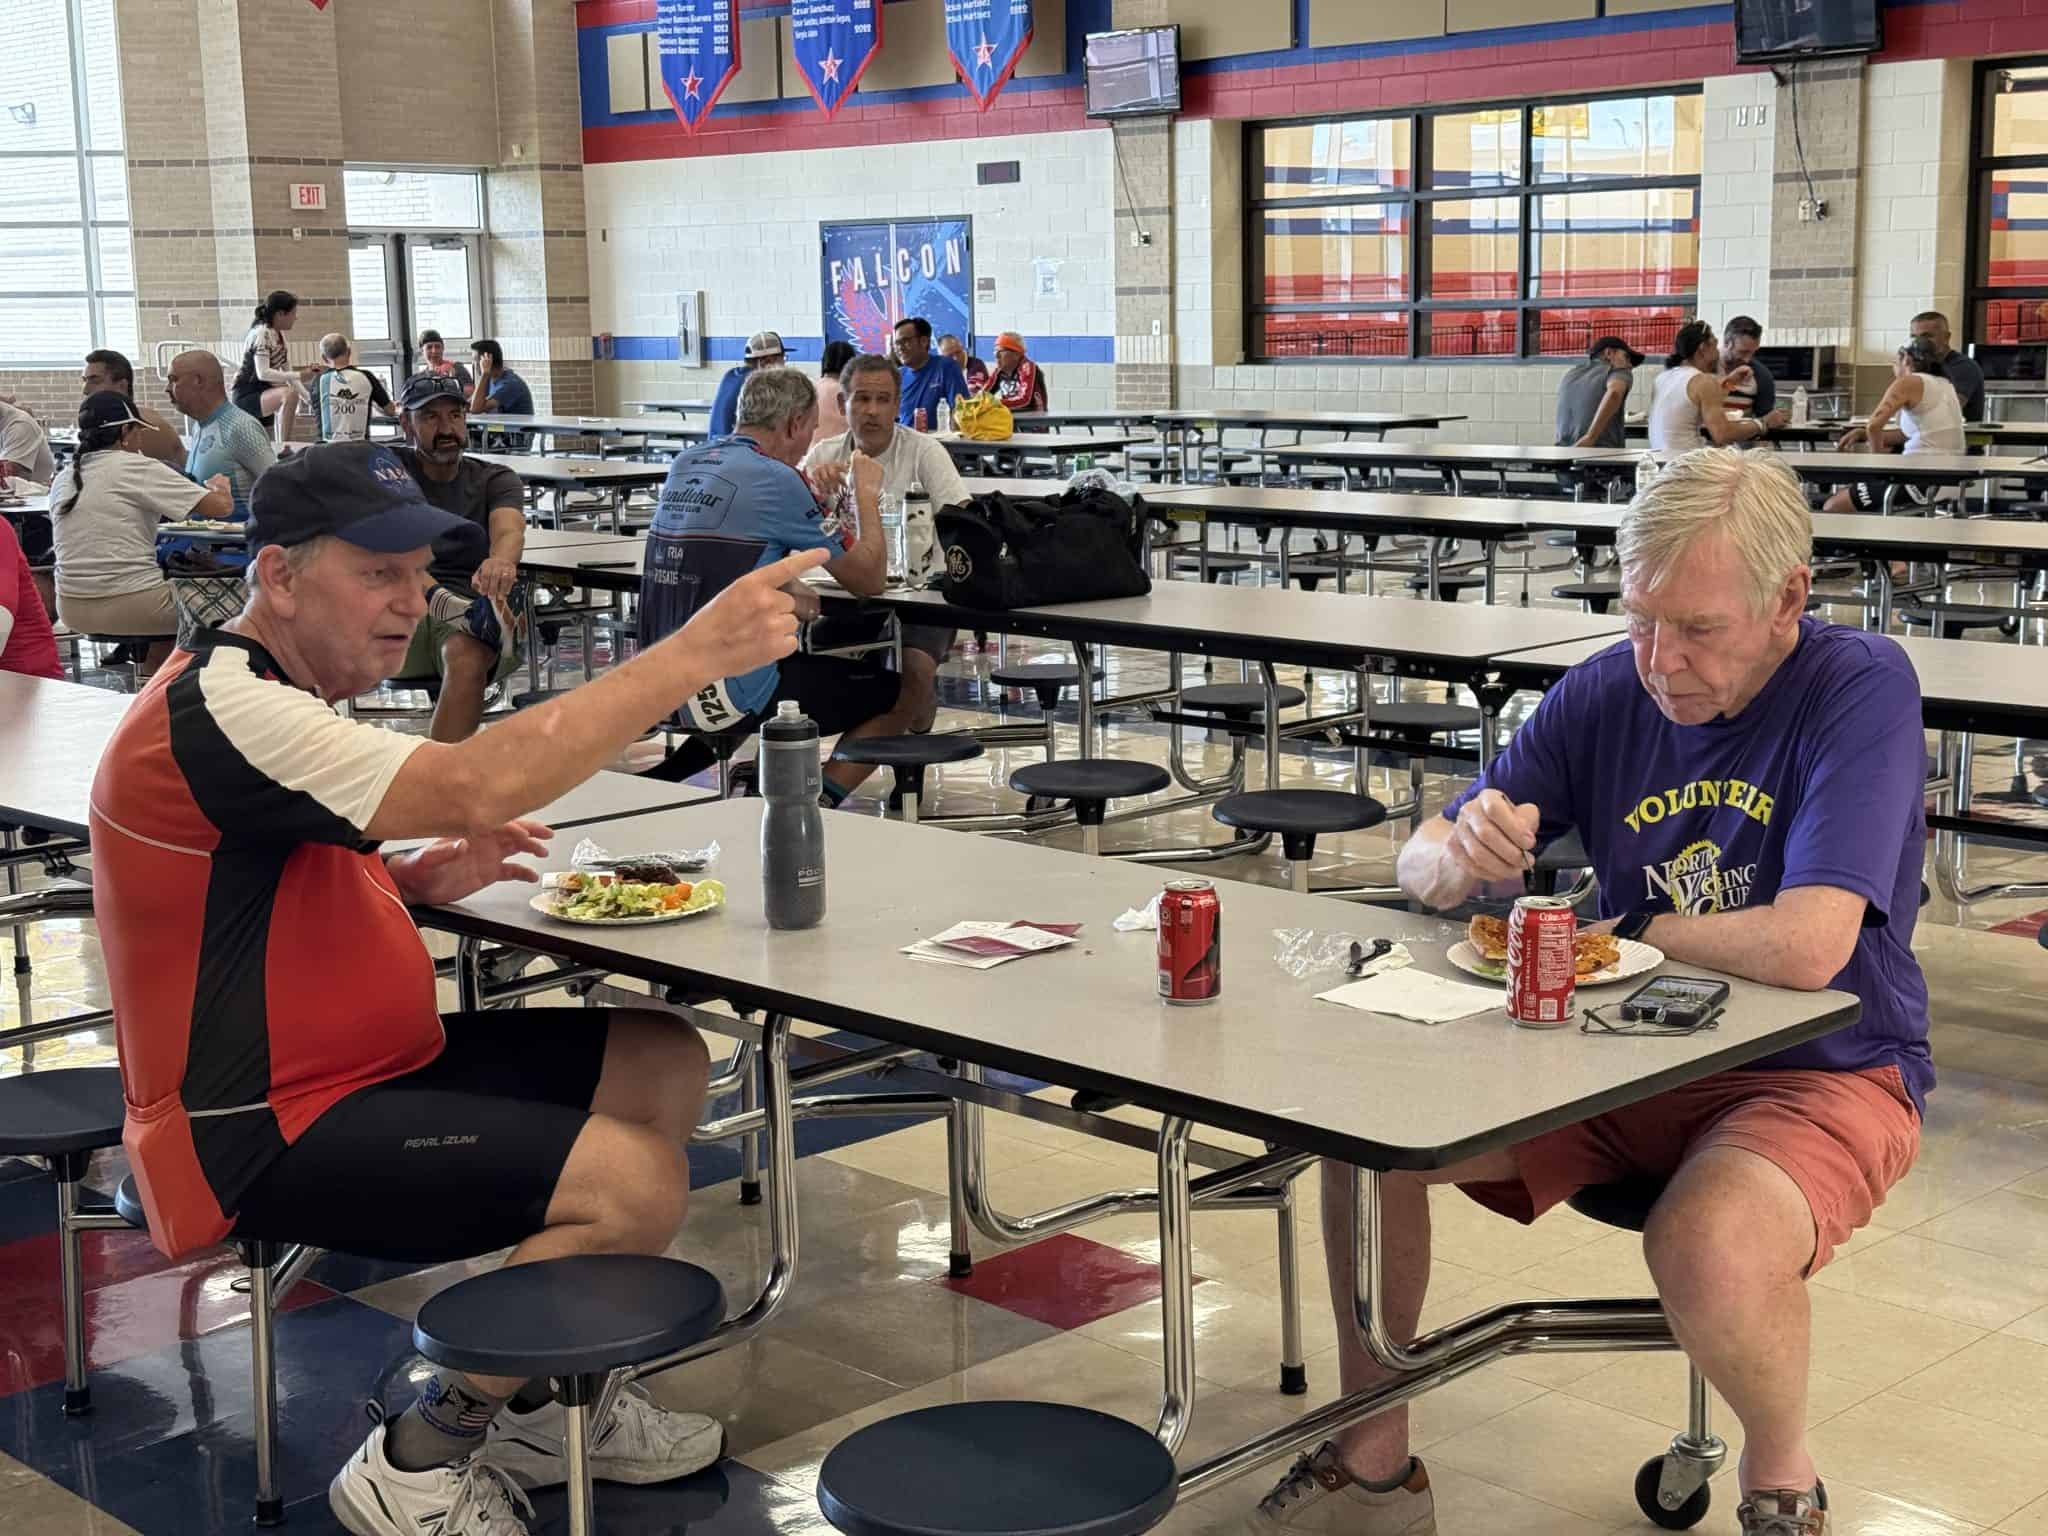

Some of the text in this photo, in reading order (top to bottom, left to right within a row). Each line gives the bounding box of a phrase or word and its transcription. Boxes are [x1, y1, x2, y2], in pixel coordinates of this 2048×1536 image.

[299, 186, 320, 205] EXIT
[830, 232, 967, 296] FALCON
[334, 405, 356, 415] 200
[662, 487, 723, 507] andlebar
[1624, 779, 1775, 833] VOLUNER
